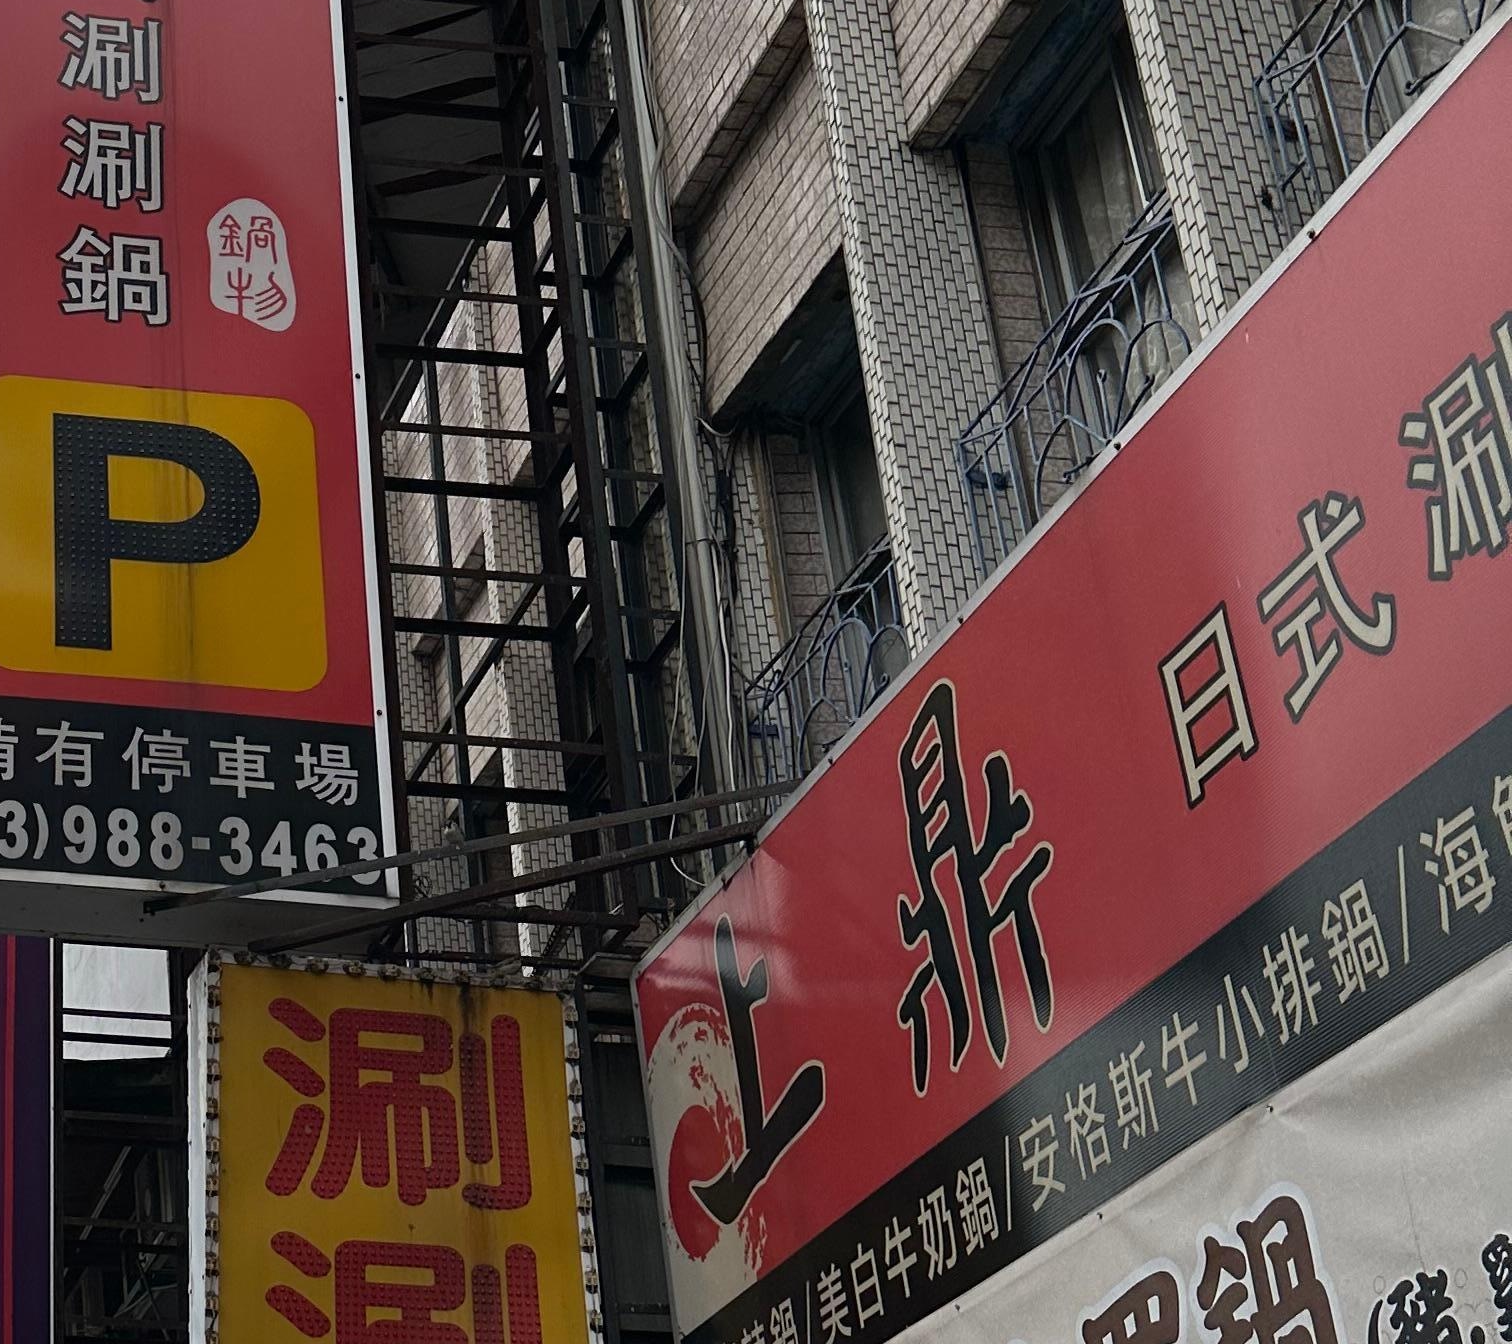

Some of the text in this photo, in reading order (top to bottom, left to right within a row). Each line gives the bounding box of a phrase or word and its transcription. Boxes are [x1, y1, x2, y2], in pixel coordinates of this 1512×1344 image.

[217, 214, 286, 322] 鍋物
[52, 412, 261, 650] P
[1158, 311, 1512, 811] 日式涮
[690, 678, 1055, 1226] 上鼎
